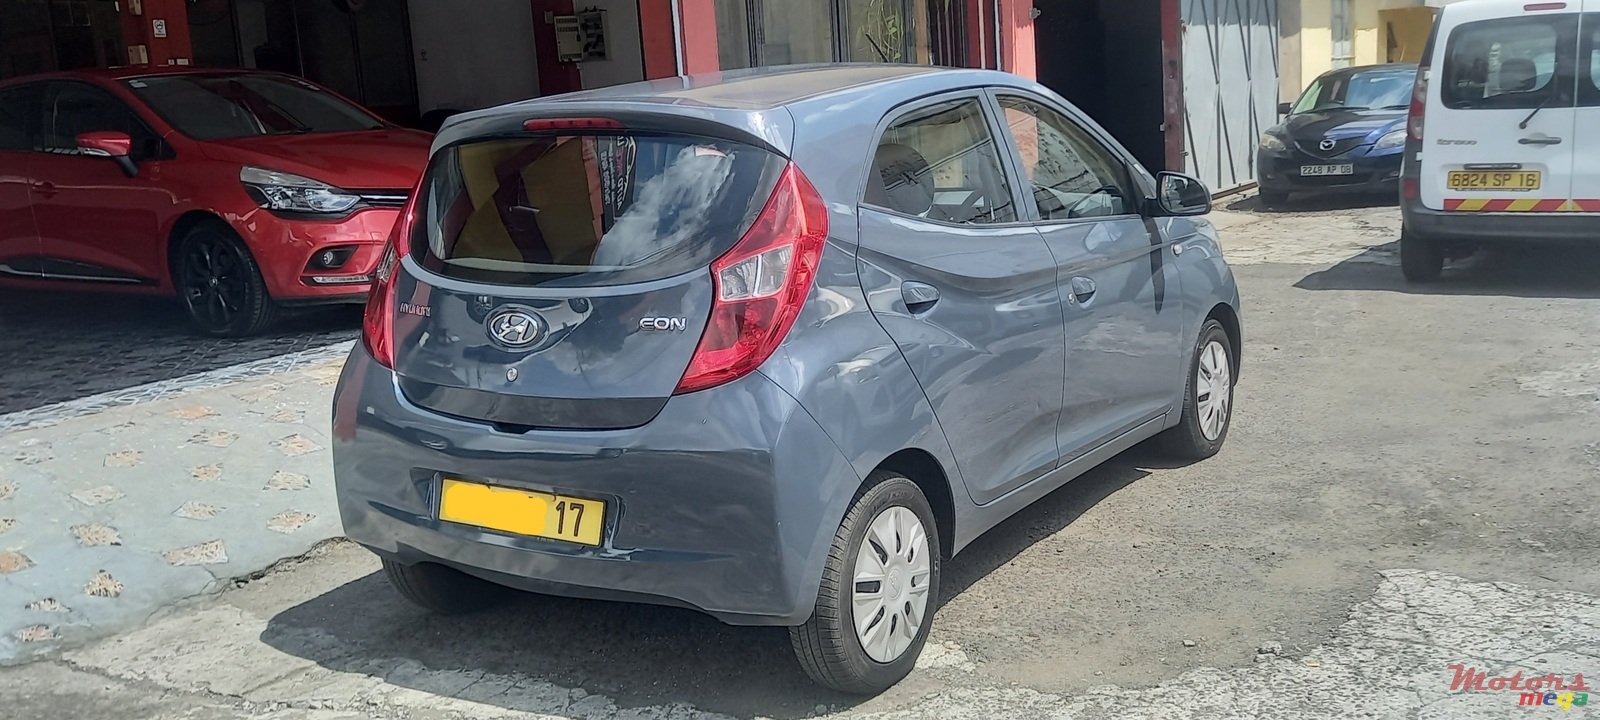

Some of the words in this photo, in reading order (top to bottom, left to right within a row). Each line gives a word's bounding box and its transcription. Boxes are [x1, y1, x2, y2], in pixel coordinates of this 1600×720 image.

[1302, 166, 1323, 175] 2248
[1452, 173, 1488, 187] 6824
[1492, 173, 1512, 187] SP
[1519, 173, 1537, 187] 16
[639, 317, 687, 331] EON
[555, 501, 585, 537] 17
